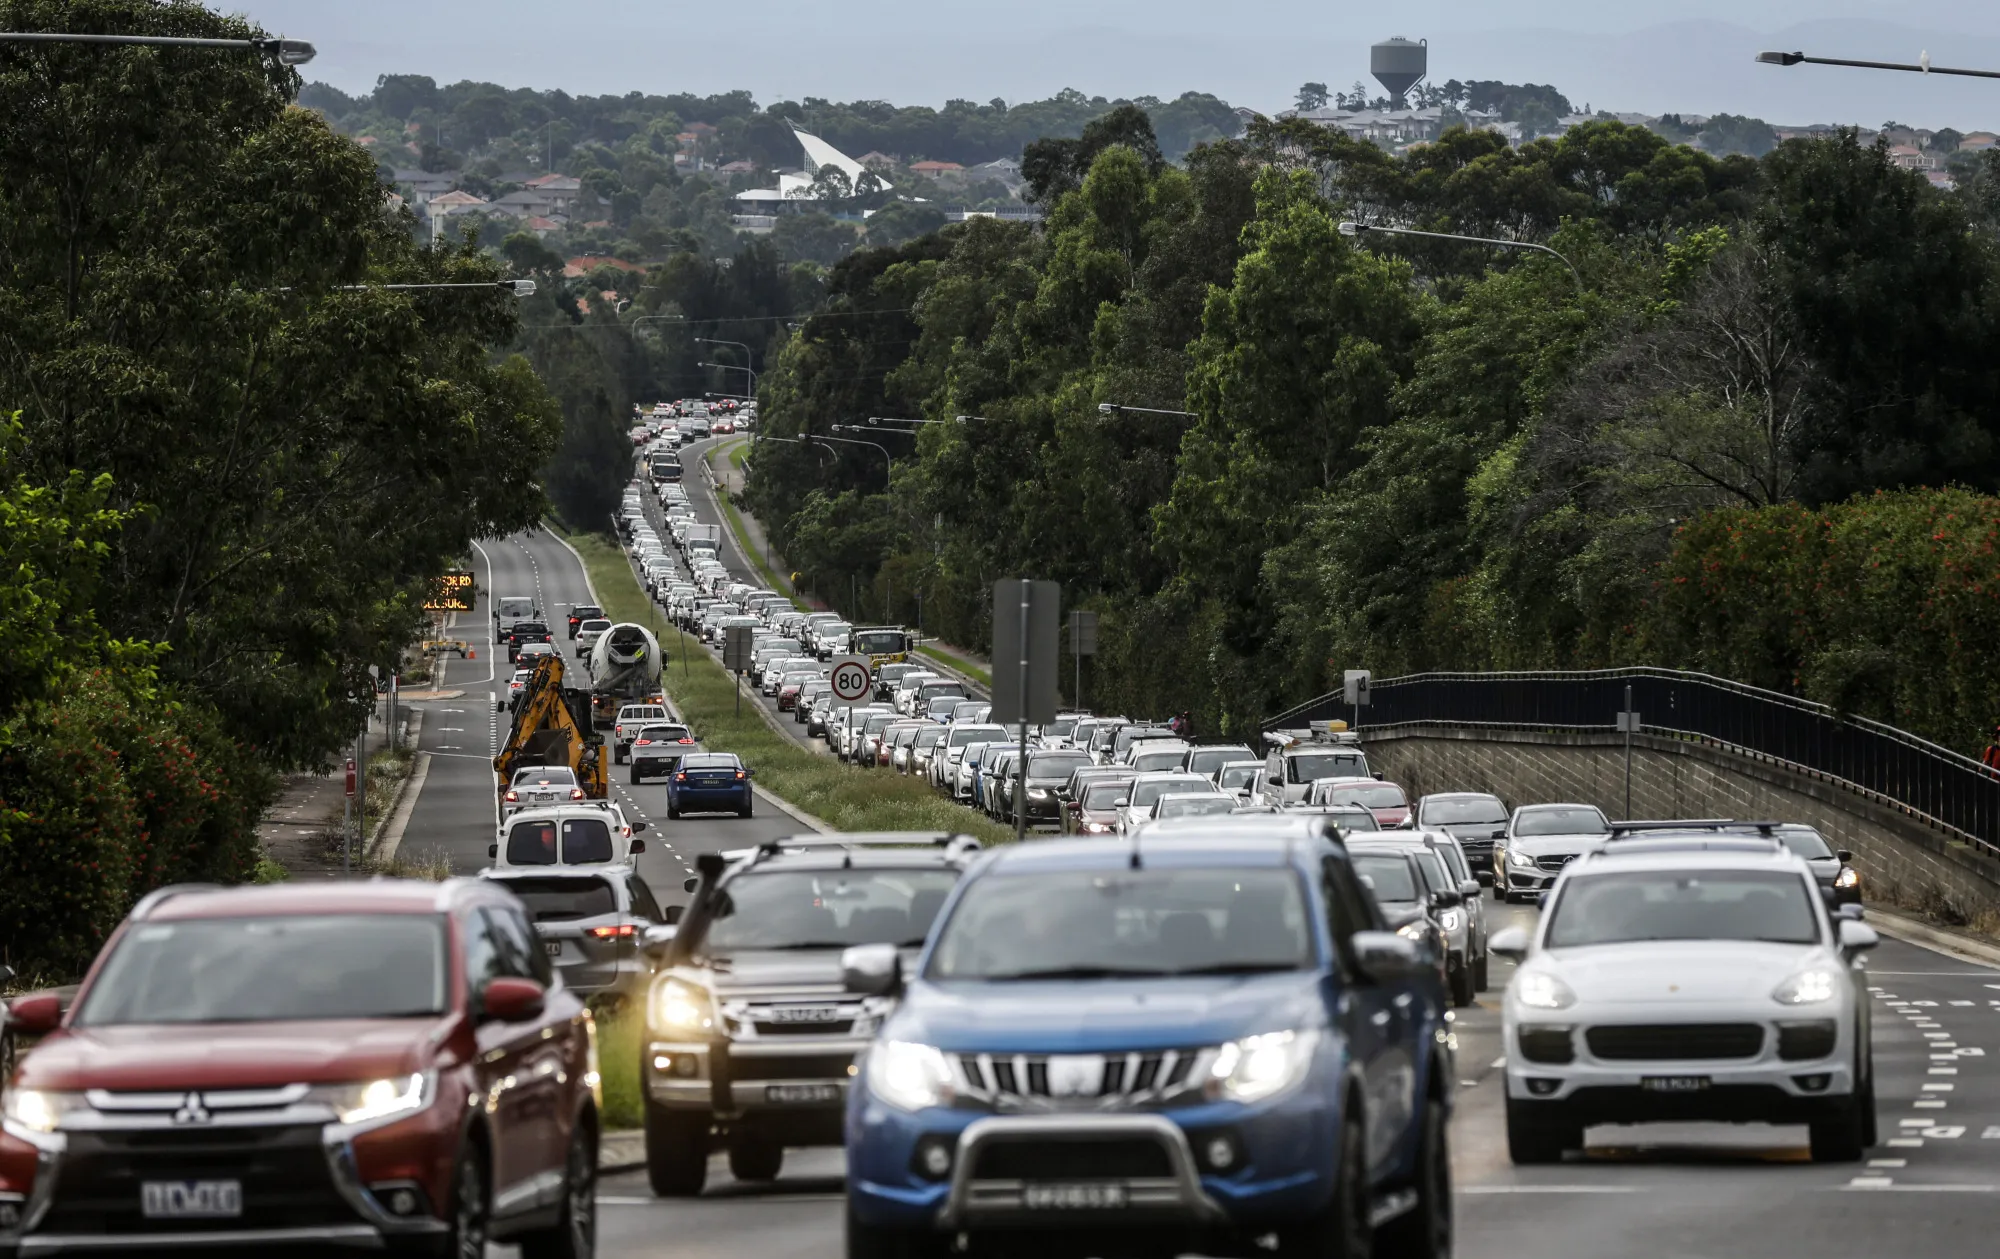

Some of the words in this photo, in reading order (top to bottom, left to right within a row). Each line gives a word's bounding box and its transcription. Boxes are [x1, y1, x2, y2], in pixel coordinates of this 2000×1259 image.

[459, 575, 472, 586] RD
[838, 673, 863, 690] 80
[773, 1007, 836, 1022] ISUZU
